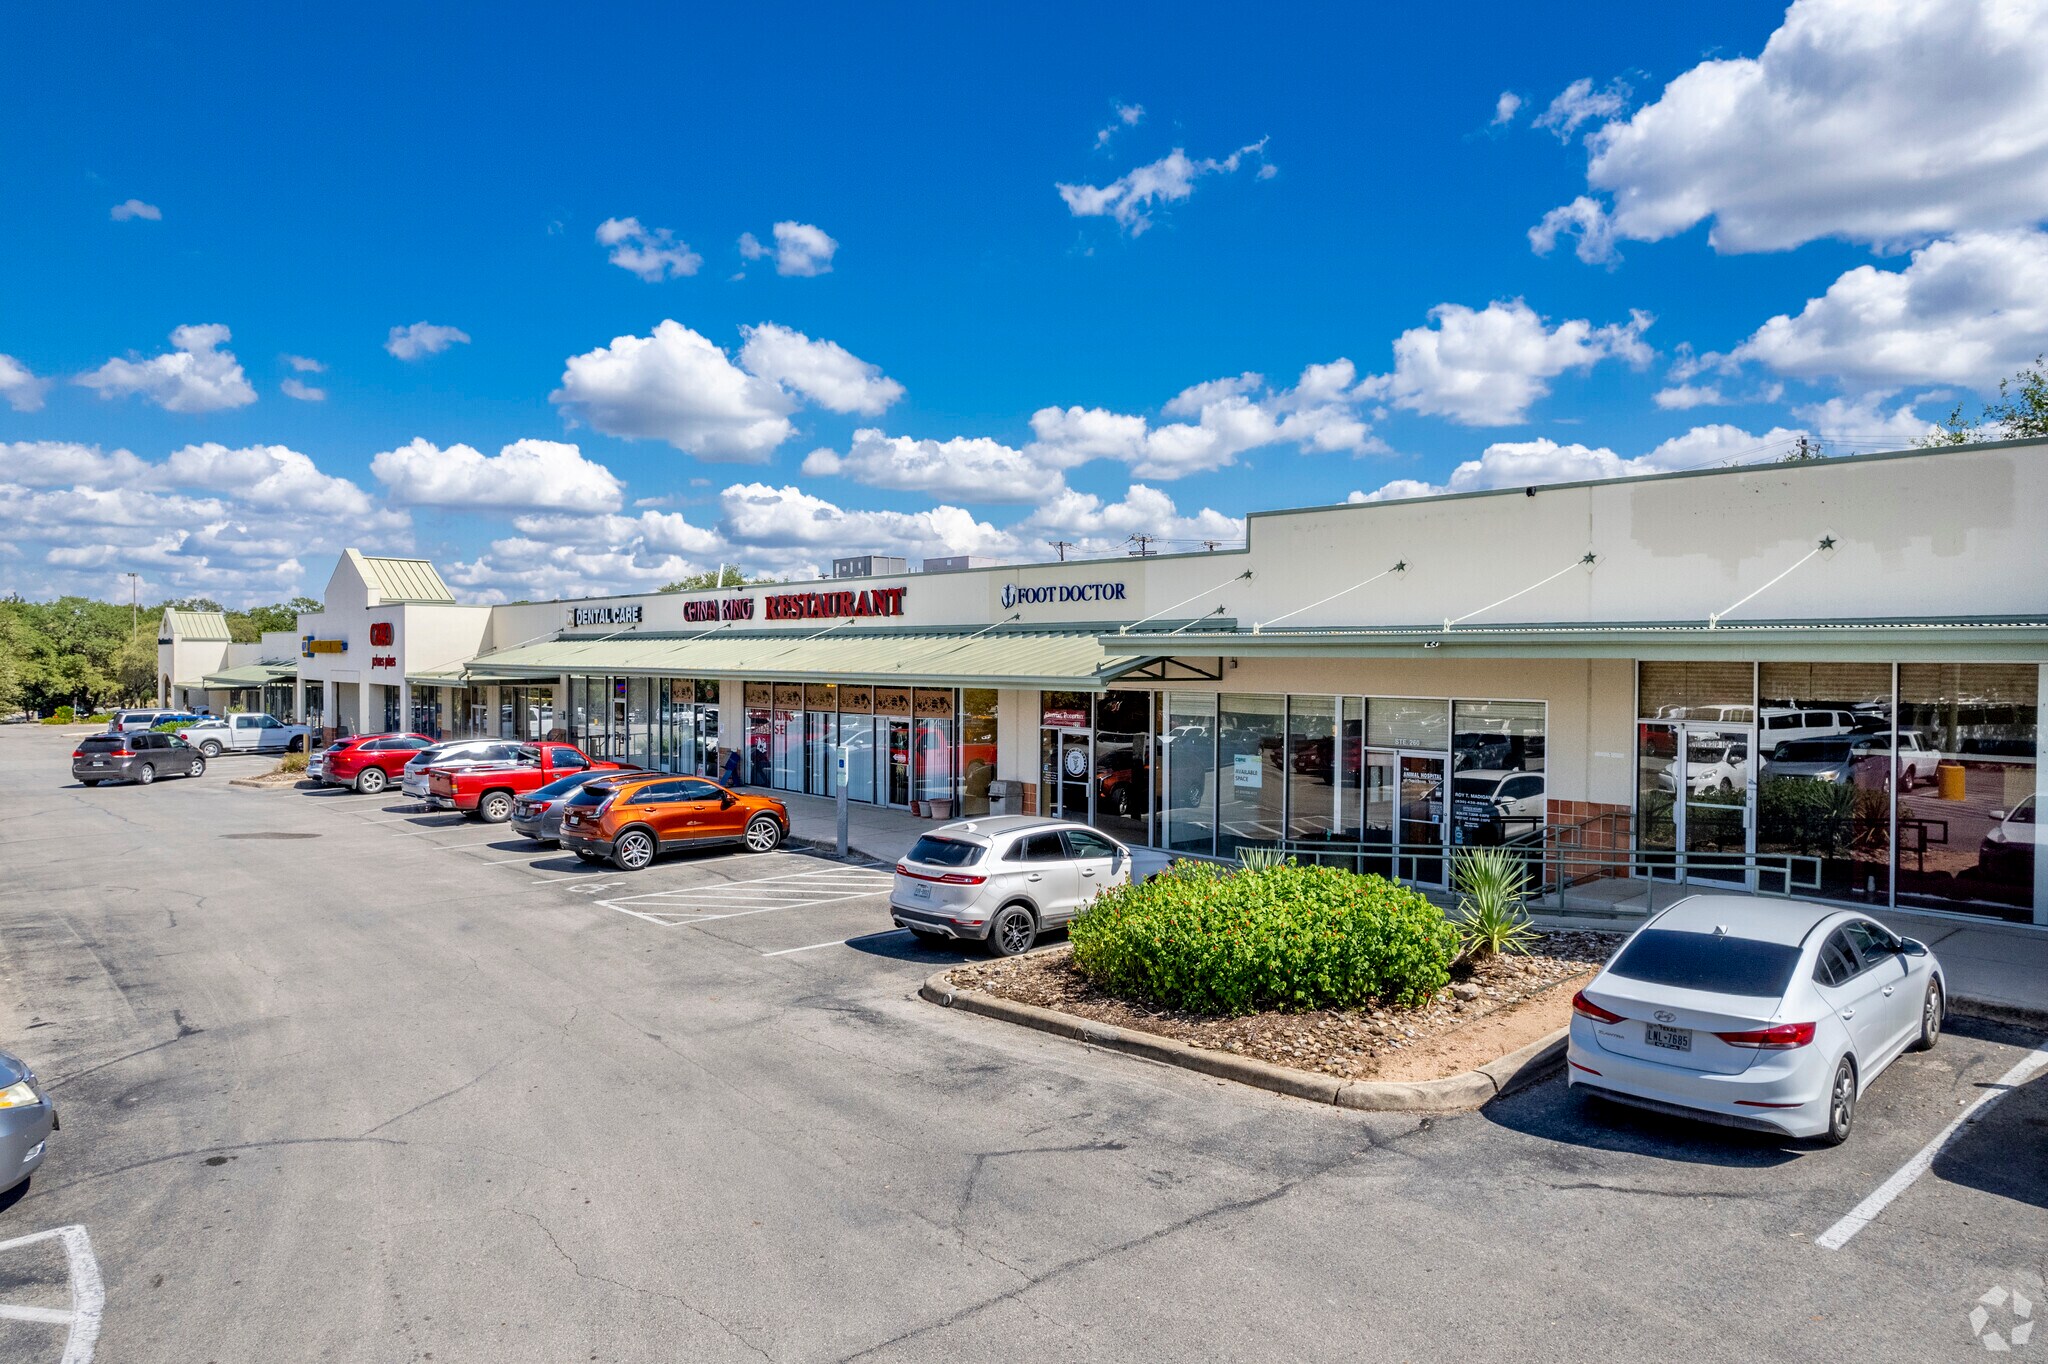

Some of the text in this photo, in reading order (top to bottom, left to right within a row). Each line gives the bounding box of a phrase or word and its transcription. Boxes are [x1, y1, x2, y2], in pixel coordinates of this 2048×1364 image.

[1018, 583, 1126, 604] FOOT DOCTOR
[683, 587, 906, 622] CHINA KING RESTAURANT
[576, 606, 639, 625] DENTAL CARE
[1420, 772, 1442, 780] HOSPITAL
[1658, 1024, 1677, 1033] TEXAS
